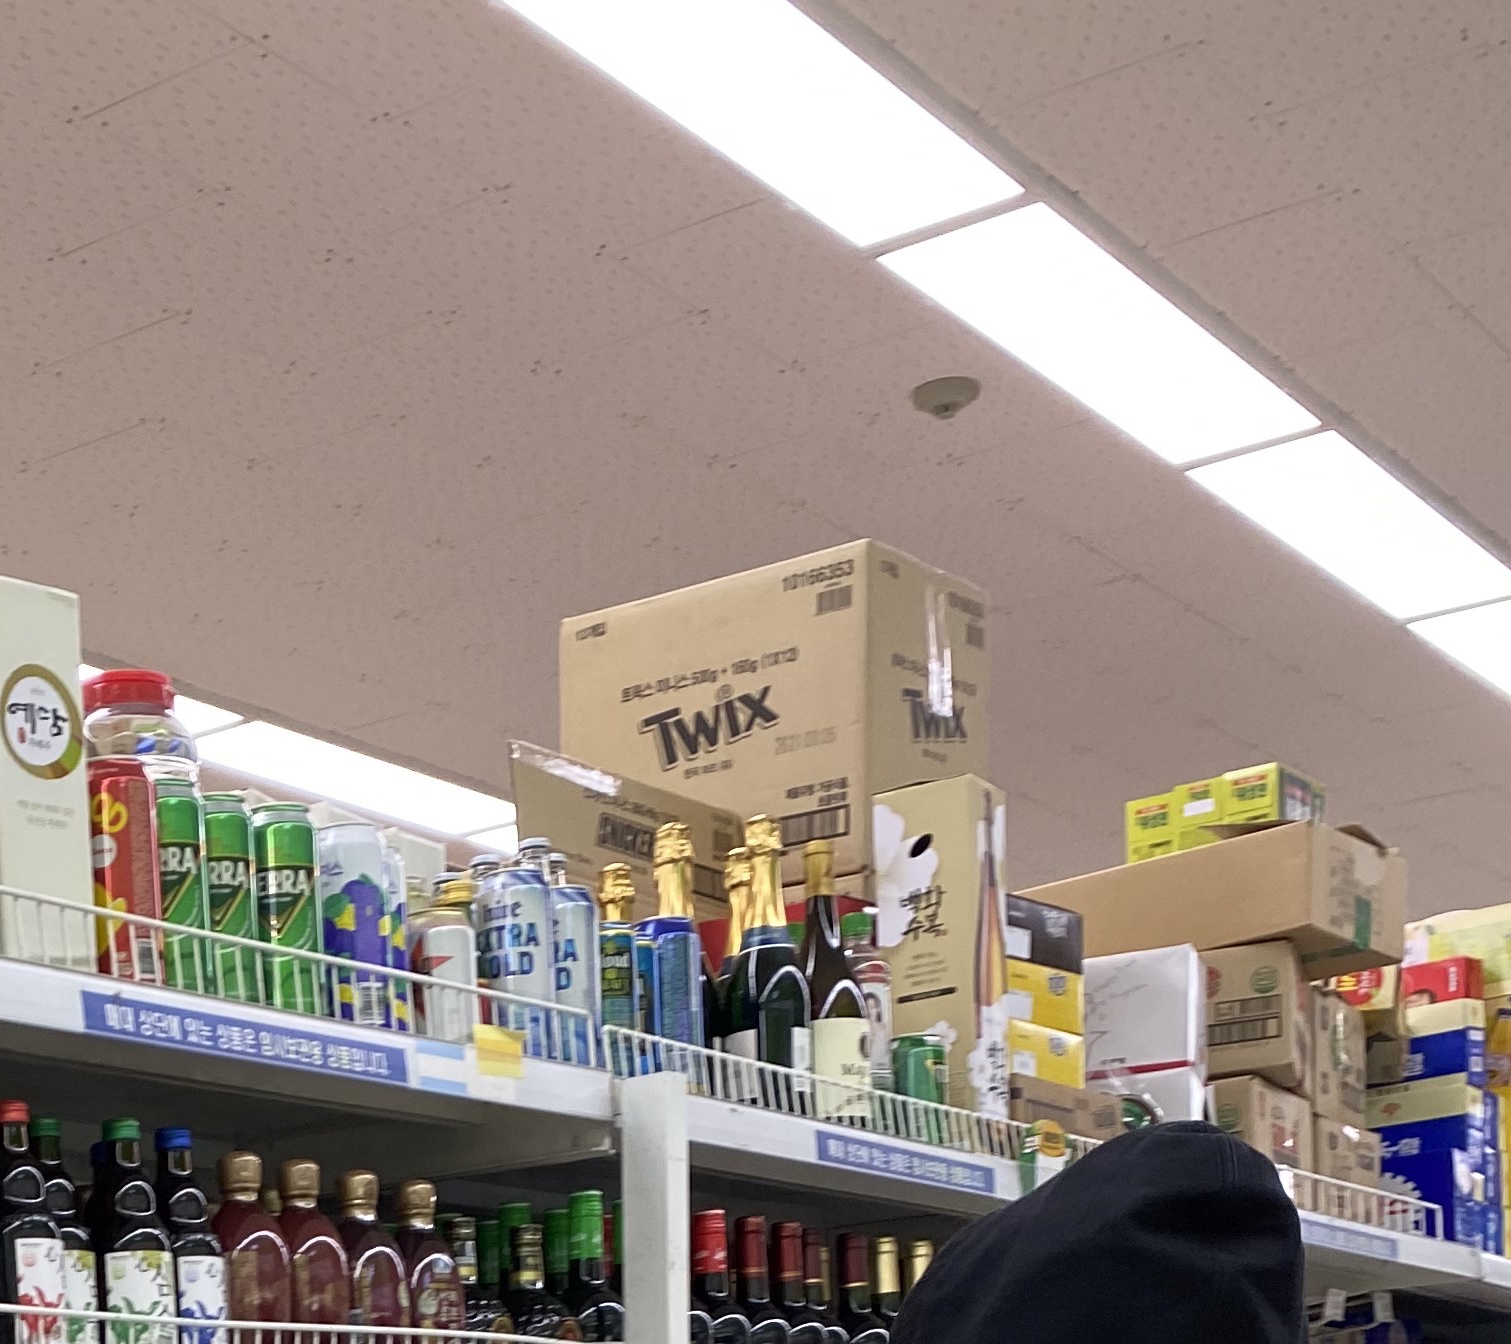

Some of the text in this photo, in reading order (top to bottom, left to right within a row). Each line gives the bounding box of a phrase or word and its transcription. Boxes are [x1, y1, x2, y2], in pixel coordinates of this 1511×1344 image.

[257, 869, 309, 898] ERRA
[184, 1018, 214, 1046] 있는
[216, 1024, 258, 1053] 상품은
